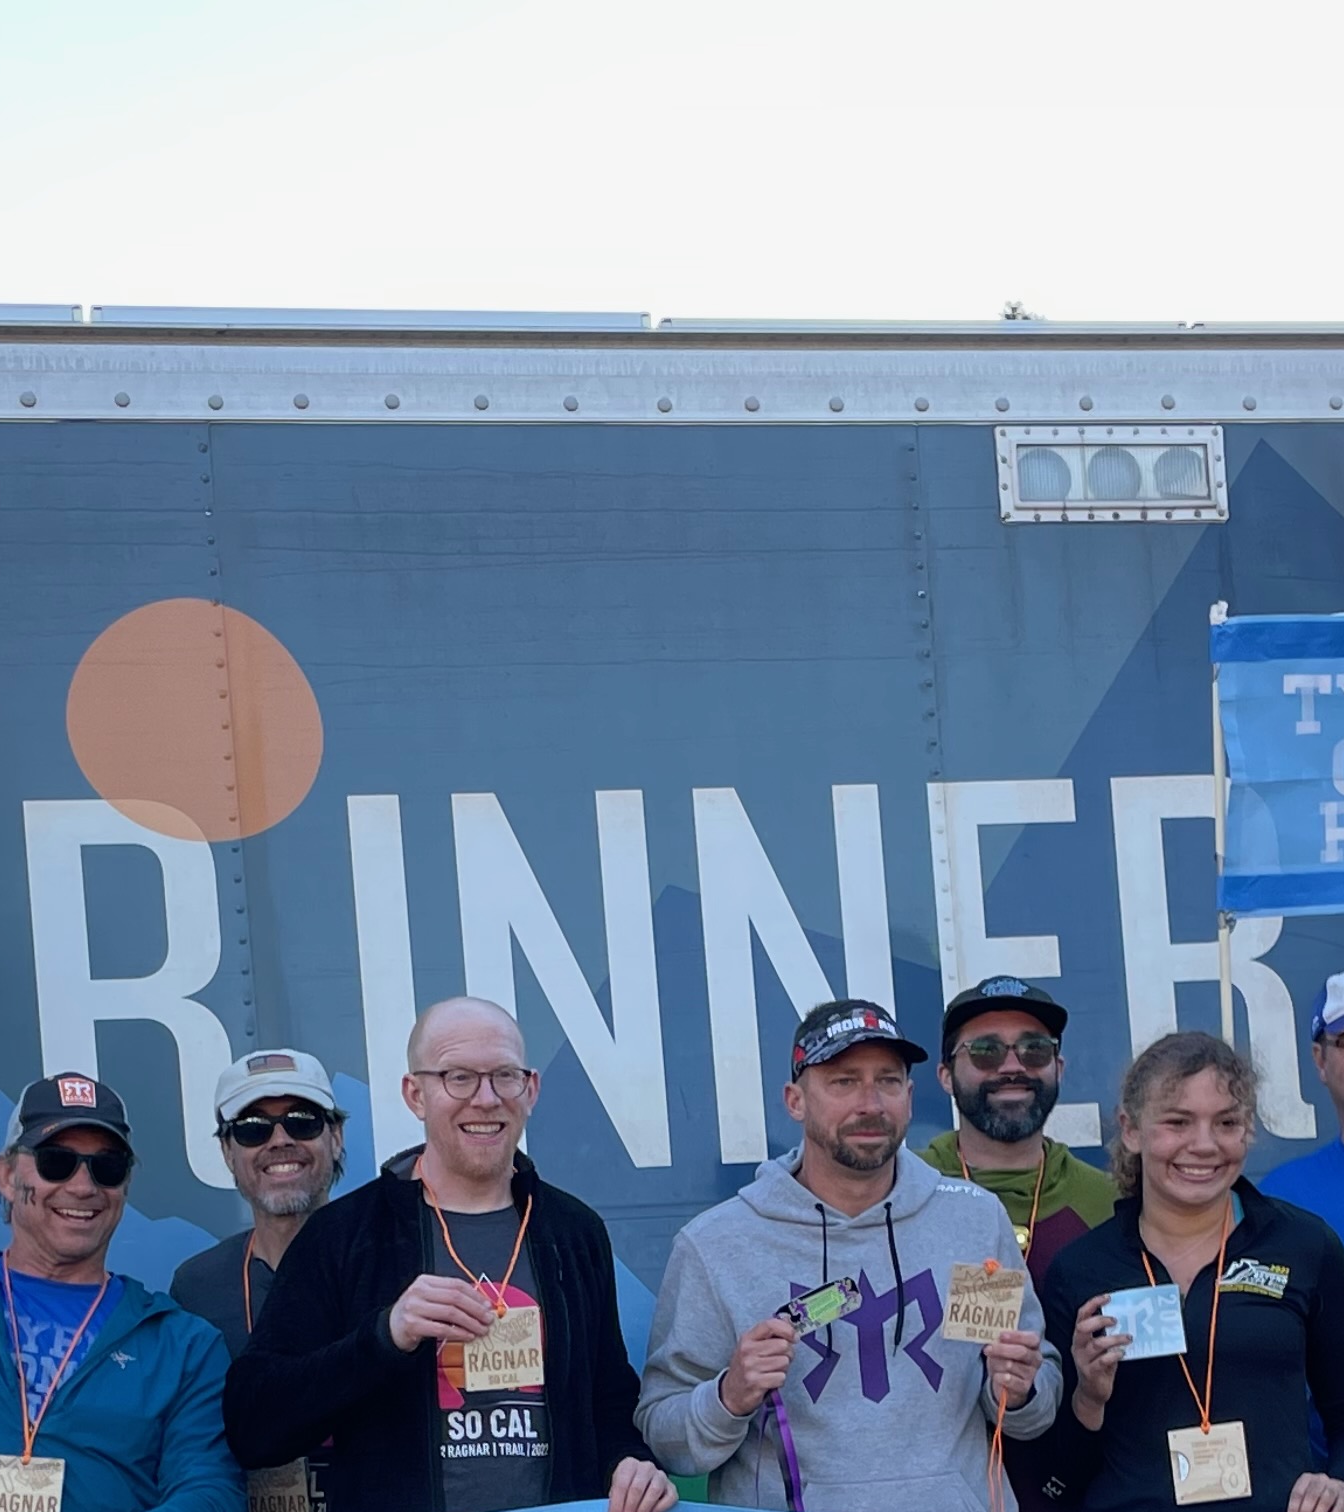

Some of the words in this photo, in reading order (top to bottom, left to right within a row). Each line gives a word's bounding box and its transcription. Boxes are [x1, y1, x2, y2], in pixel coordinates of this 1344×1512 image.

[347, 775, 1317, 1174] INNER
[937, 1184, 971, 1193] RAFT
[948, 1303, 1017, 1329] RAGNAR
[468, 1348, 540, 1373] RAGNAR
[502, 1373, 520, 1384] CAL
[447, 1410, 483, 1440] SO
[490, 1409, 538, 1439] CAL
[447, 1442, 490, 1458] RAGNAR
[498, 1442, 525, 1456] TRAIL
